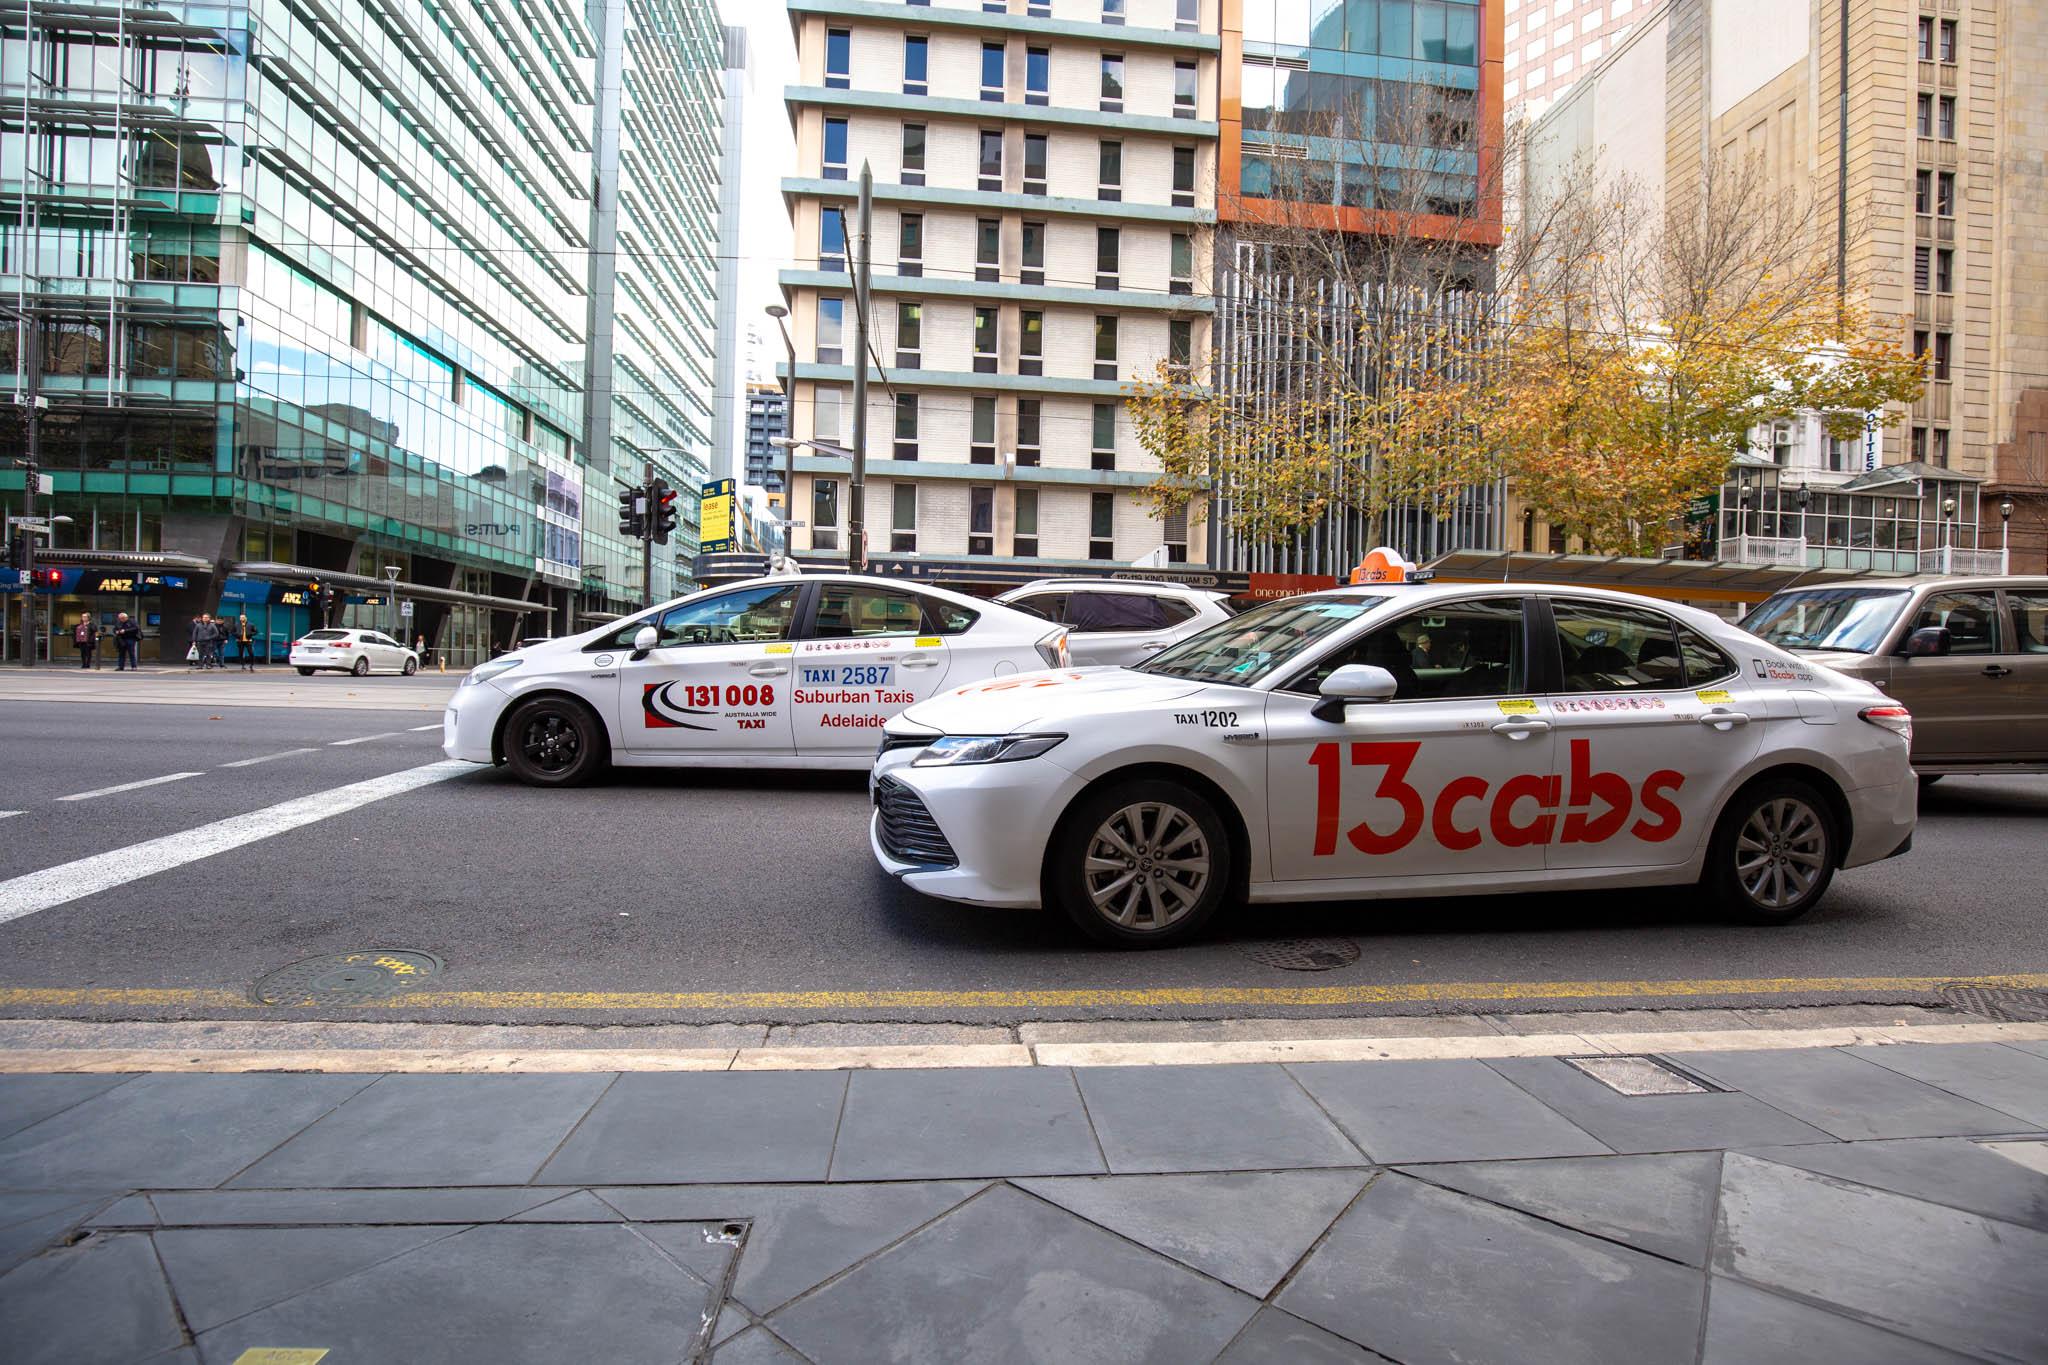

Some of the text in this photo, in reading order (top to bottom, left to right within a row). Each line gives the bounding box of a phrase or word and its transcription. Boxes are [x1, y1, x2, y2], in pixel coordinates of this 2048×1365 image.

[98, 578, 133, 591] ANZ
[145, 576, 159, 584] ANZ
[1167, 576, 1200, 584] WILLIAM
[1202, 577, 1215, 585] ST.
[281, 592, 302, 604] ANZ
[1255, 588, 1274, 598] one
[1275, 589, 1295, 598] one
[1766, 660, 1787, 669] Book
[804, 667, 890, 685] TAXI 2587
[1769, 669, 1796, 680] 13cabs
[685, 685, 775, 706] 131 008
[794, 689, 914, 703] Suburban Taxis
[737, 720, 766, 729] TAXI
[820, 714, 888, 727] Adelaide
[1174, 710, 1239, 727] TAXI 1202
[1308, 739, 1685, 856] 13cabs
